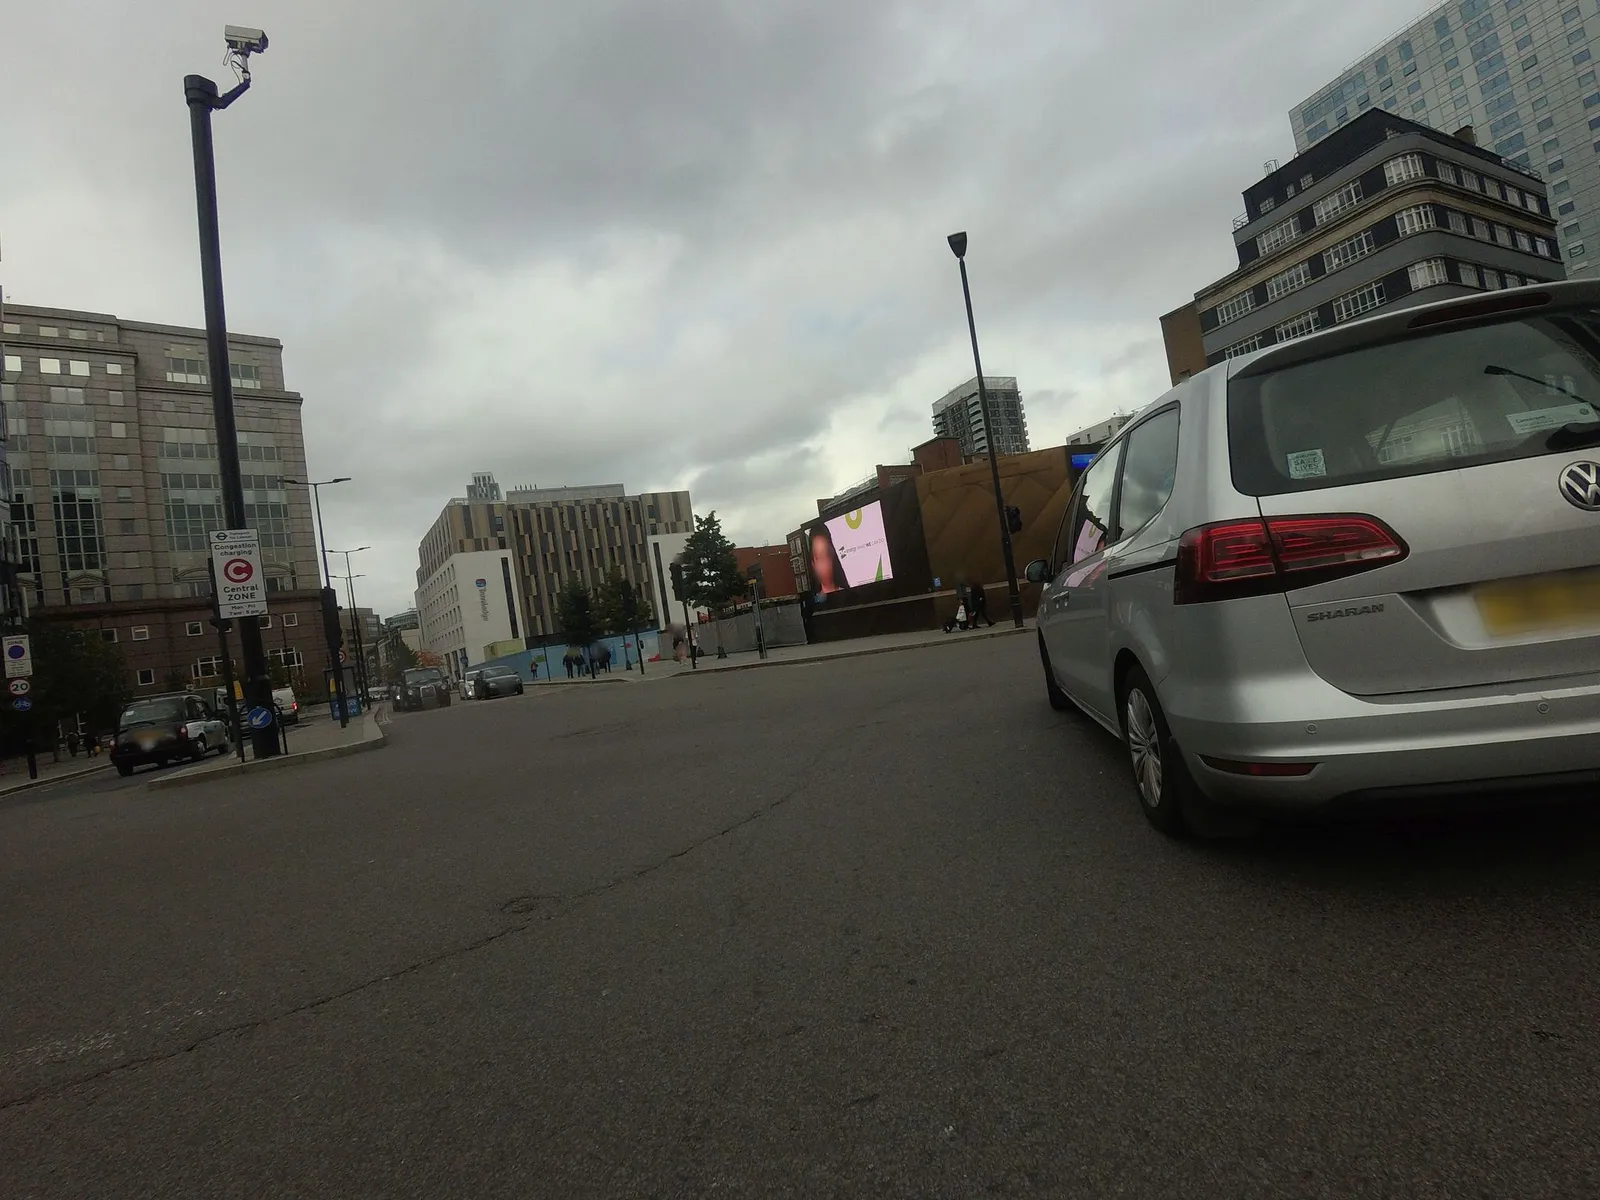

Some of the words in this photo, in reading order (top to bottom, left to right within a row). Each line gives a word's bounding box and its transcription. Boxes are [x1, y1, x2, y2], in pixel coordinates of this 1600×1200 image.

[214, 543, 257, 551] Congestion
[223, 584, 259, 593] Central
[228, 592, 256, 601] ZONE
[1307, 604, 1384, 622] SHARAN
[12, 683, 28, 691] 20
